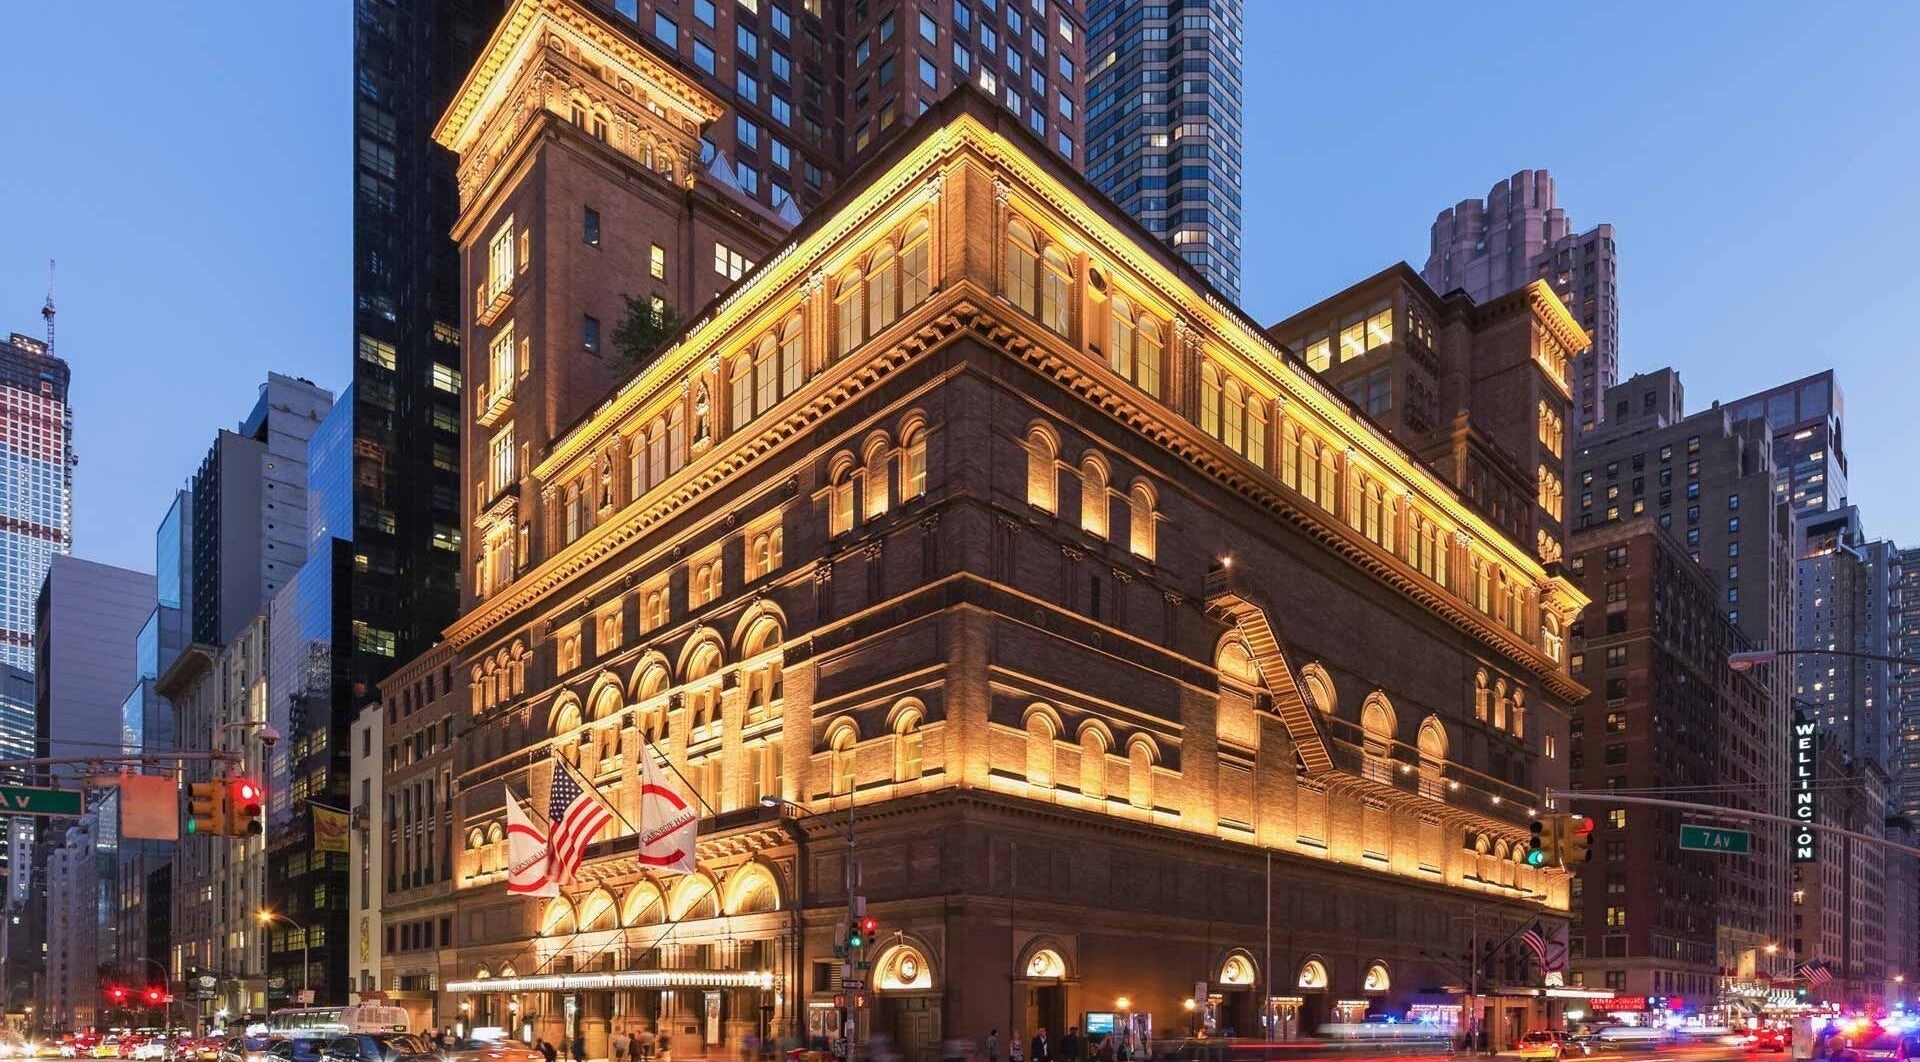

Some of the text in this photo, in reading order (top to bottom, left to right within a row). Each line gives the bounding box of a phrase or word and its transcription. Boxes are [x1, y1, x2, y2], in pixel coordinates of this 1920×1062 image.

[641, 809, 695, 844] CARNEGIE HALL
[1703, 832, 1710, 846] 7
